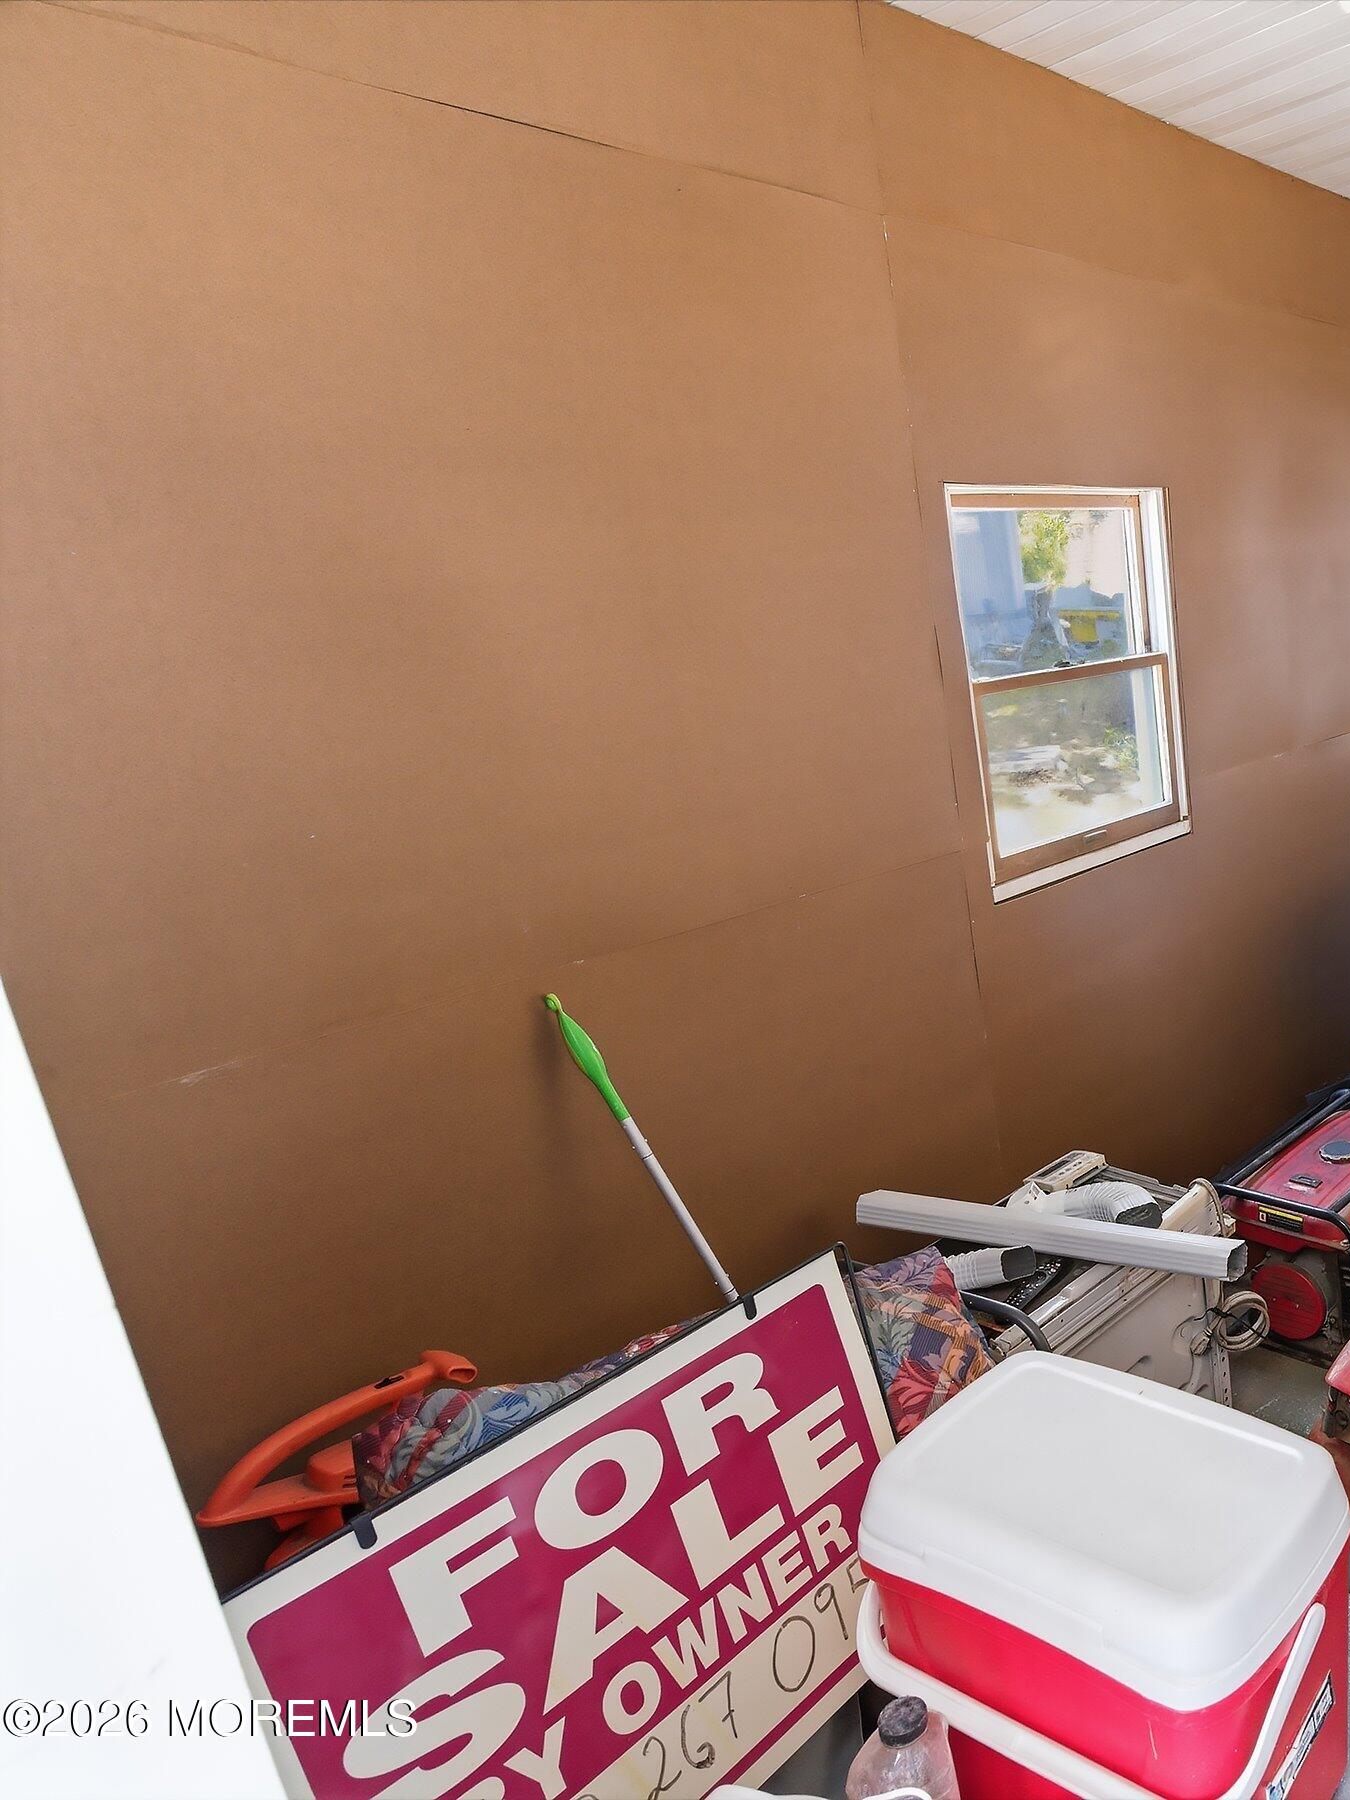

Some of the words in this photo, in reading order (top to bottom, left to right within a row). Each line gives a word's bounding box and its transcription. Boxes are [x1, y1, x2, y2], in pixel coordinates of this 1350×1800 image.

[343, 1385, 864, 1800] SALE
[389, 1352, 780, 1658] FOR
[455, 1715, 567, 1800] Y
[602, 1503, 852, 1735] OWNER
